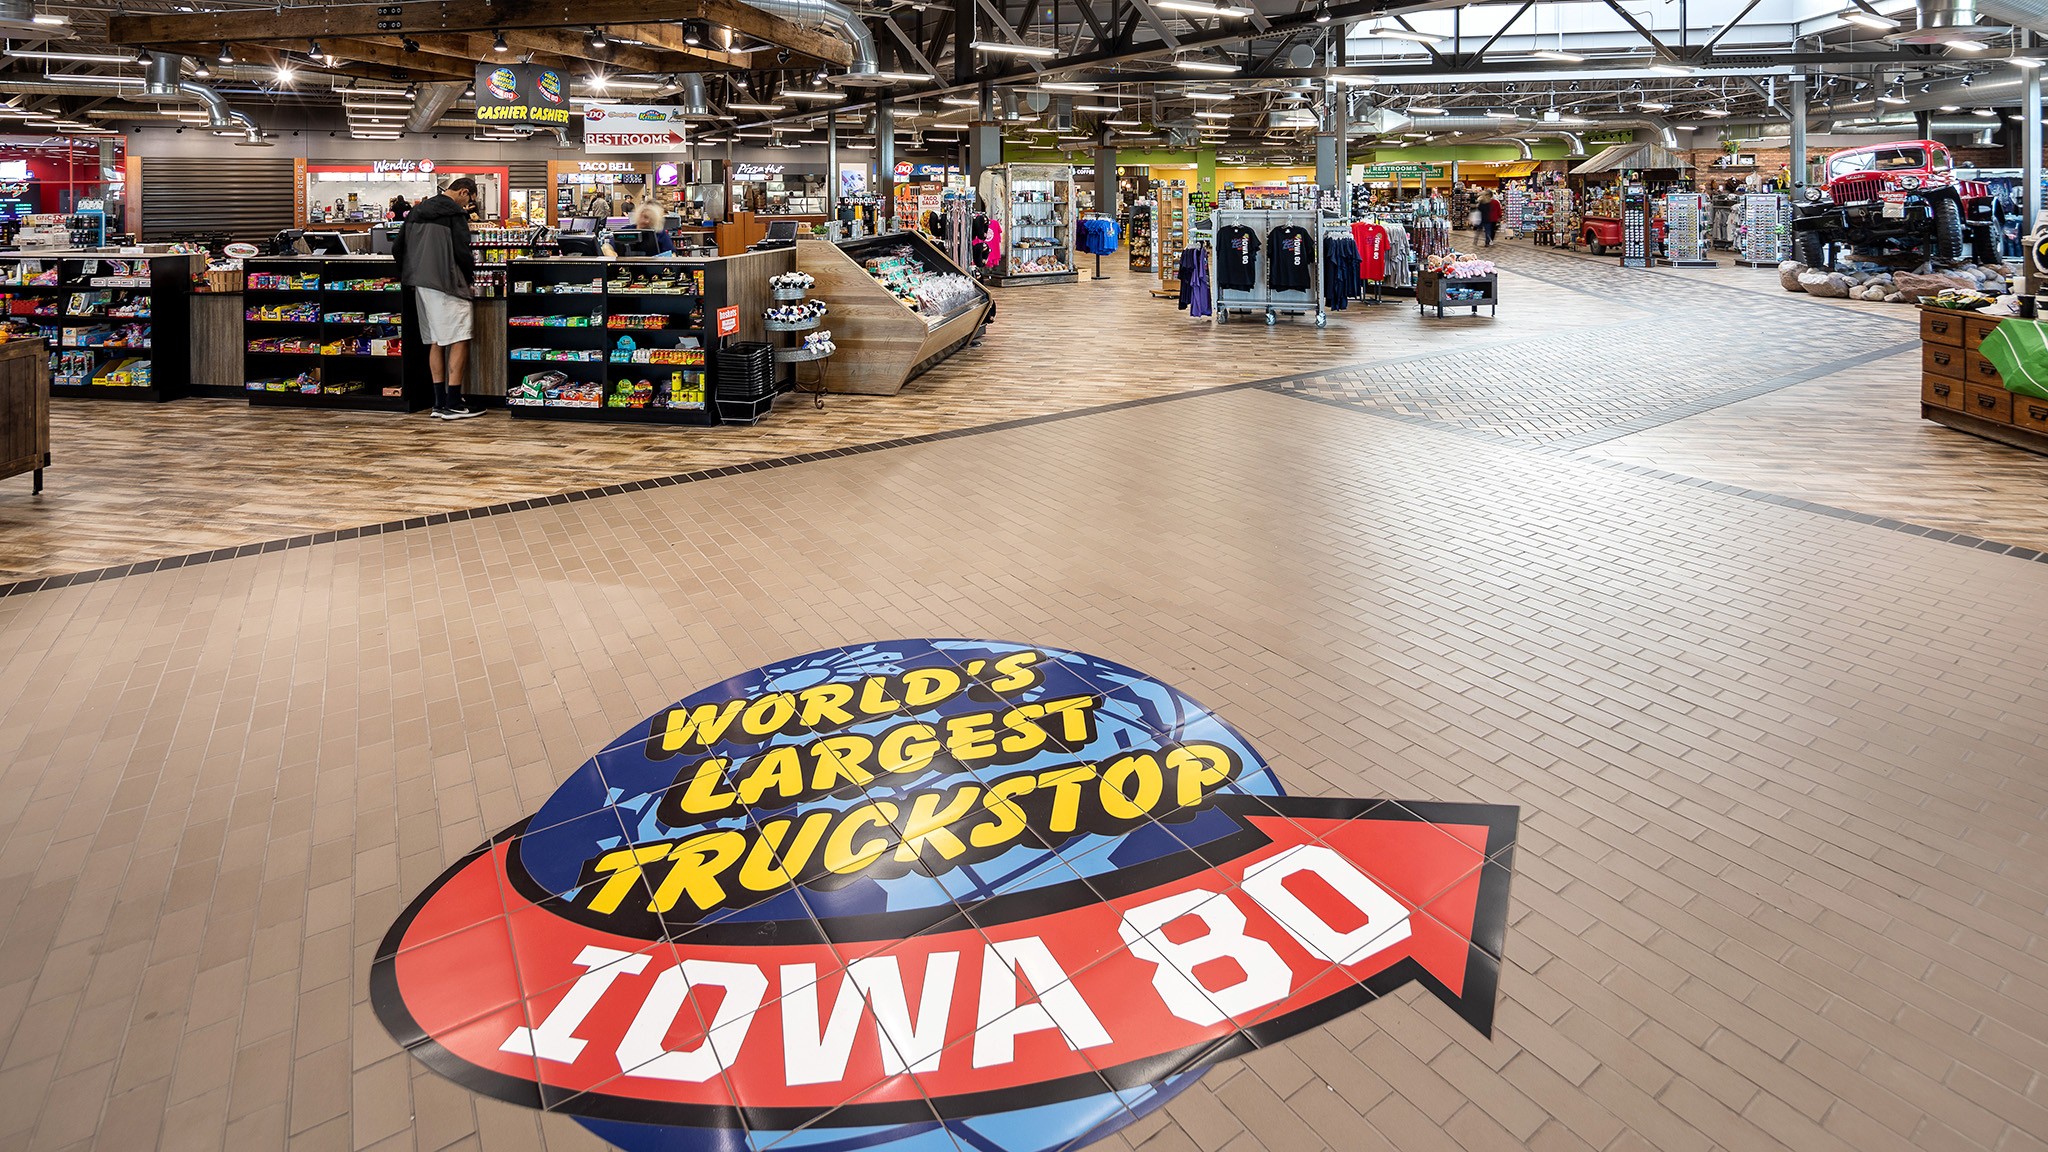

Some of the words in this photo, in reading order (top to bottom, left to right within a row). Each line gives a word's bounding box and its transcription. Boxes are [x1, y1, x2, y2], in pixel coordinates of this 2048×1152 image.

[488, 83, 504, 98] IOWA
[538, 86, 551, 99] IOWA
[550, 94, 559, 102] 80
[477, 105, 528, 120] CASHIER
[529, 106, 569, 124] CASHIER
[589, 111, 603, 119] DQ
[587, 134, 670, 145] RESTROOMS
[373, 158, 416, 173] Wendy's
[578, 162, 608, 172] TACO
[608, 162, 635, 172] BELL
[736, 164, 764, 174] Pizza
[764, 164, 785, 174] Hut
[897, 165, 911, 173] DQ
[844, 196, 876, 204] DURACELL
[1293, 237, 1301, 256] IOWA
[1373, 236, 1381, 253] IOWA
[660, 650, 1042, 753] WORLD'S
[680, 695, 1094, 814] LARGEST
[586, 743, 1236, 915] TRUCKSTOP
[499, 935, 1114, 1087] IOWA
[1118, 843, 1413, 1027] 80
